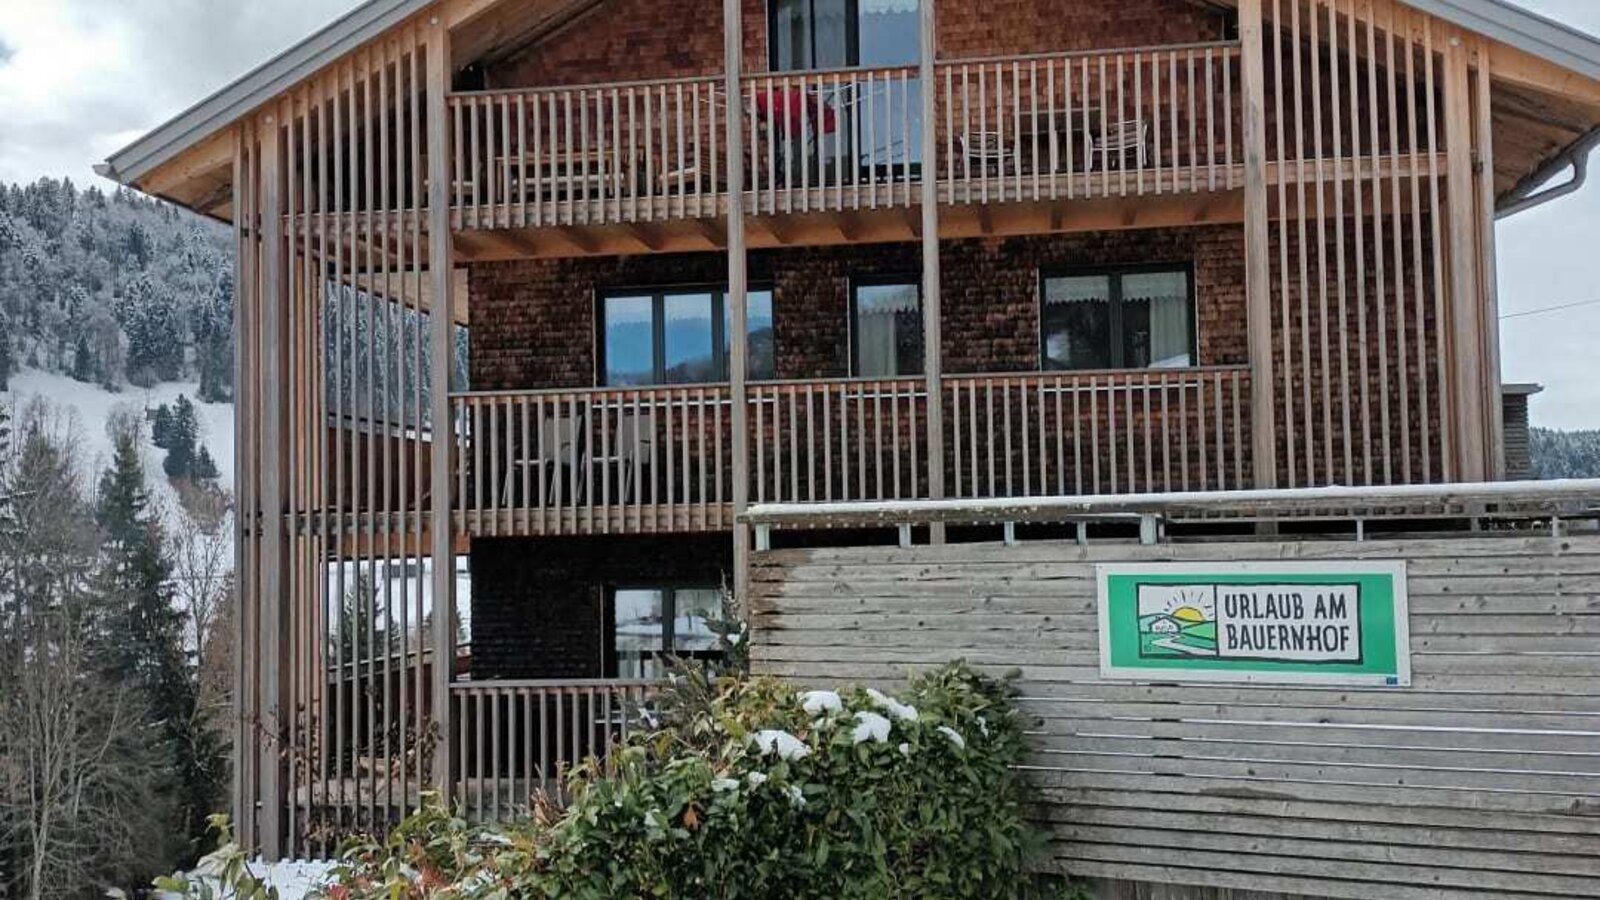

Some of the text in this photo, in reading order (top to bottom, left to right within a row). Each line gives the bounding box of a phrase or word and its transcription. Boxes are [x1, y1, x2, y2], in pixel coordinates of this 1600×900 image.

[1225, 593, 1347, 619] URLAUB AM
[1226, 624, 1350, 652] BAUERNHOF
